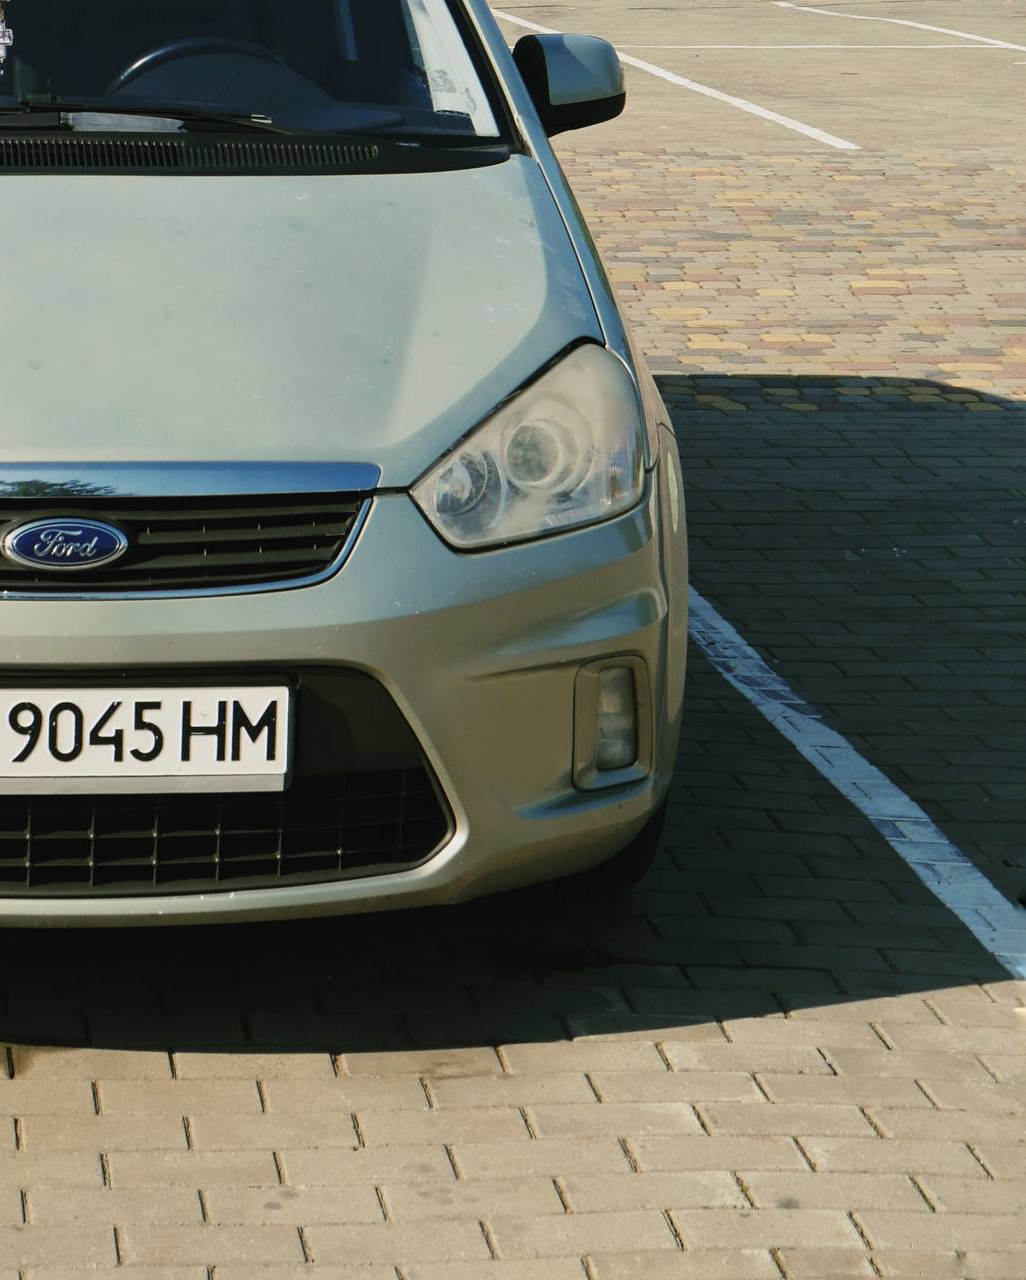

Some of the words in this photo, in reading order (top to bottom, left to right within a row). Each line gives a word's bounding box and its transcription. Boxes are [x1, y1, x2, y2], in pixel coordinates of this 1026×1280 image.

[33, 528, 99, 557] Ford
[8, 701, 164, 762] 9045
[181, 700, 278, 761] HM
